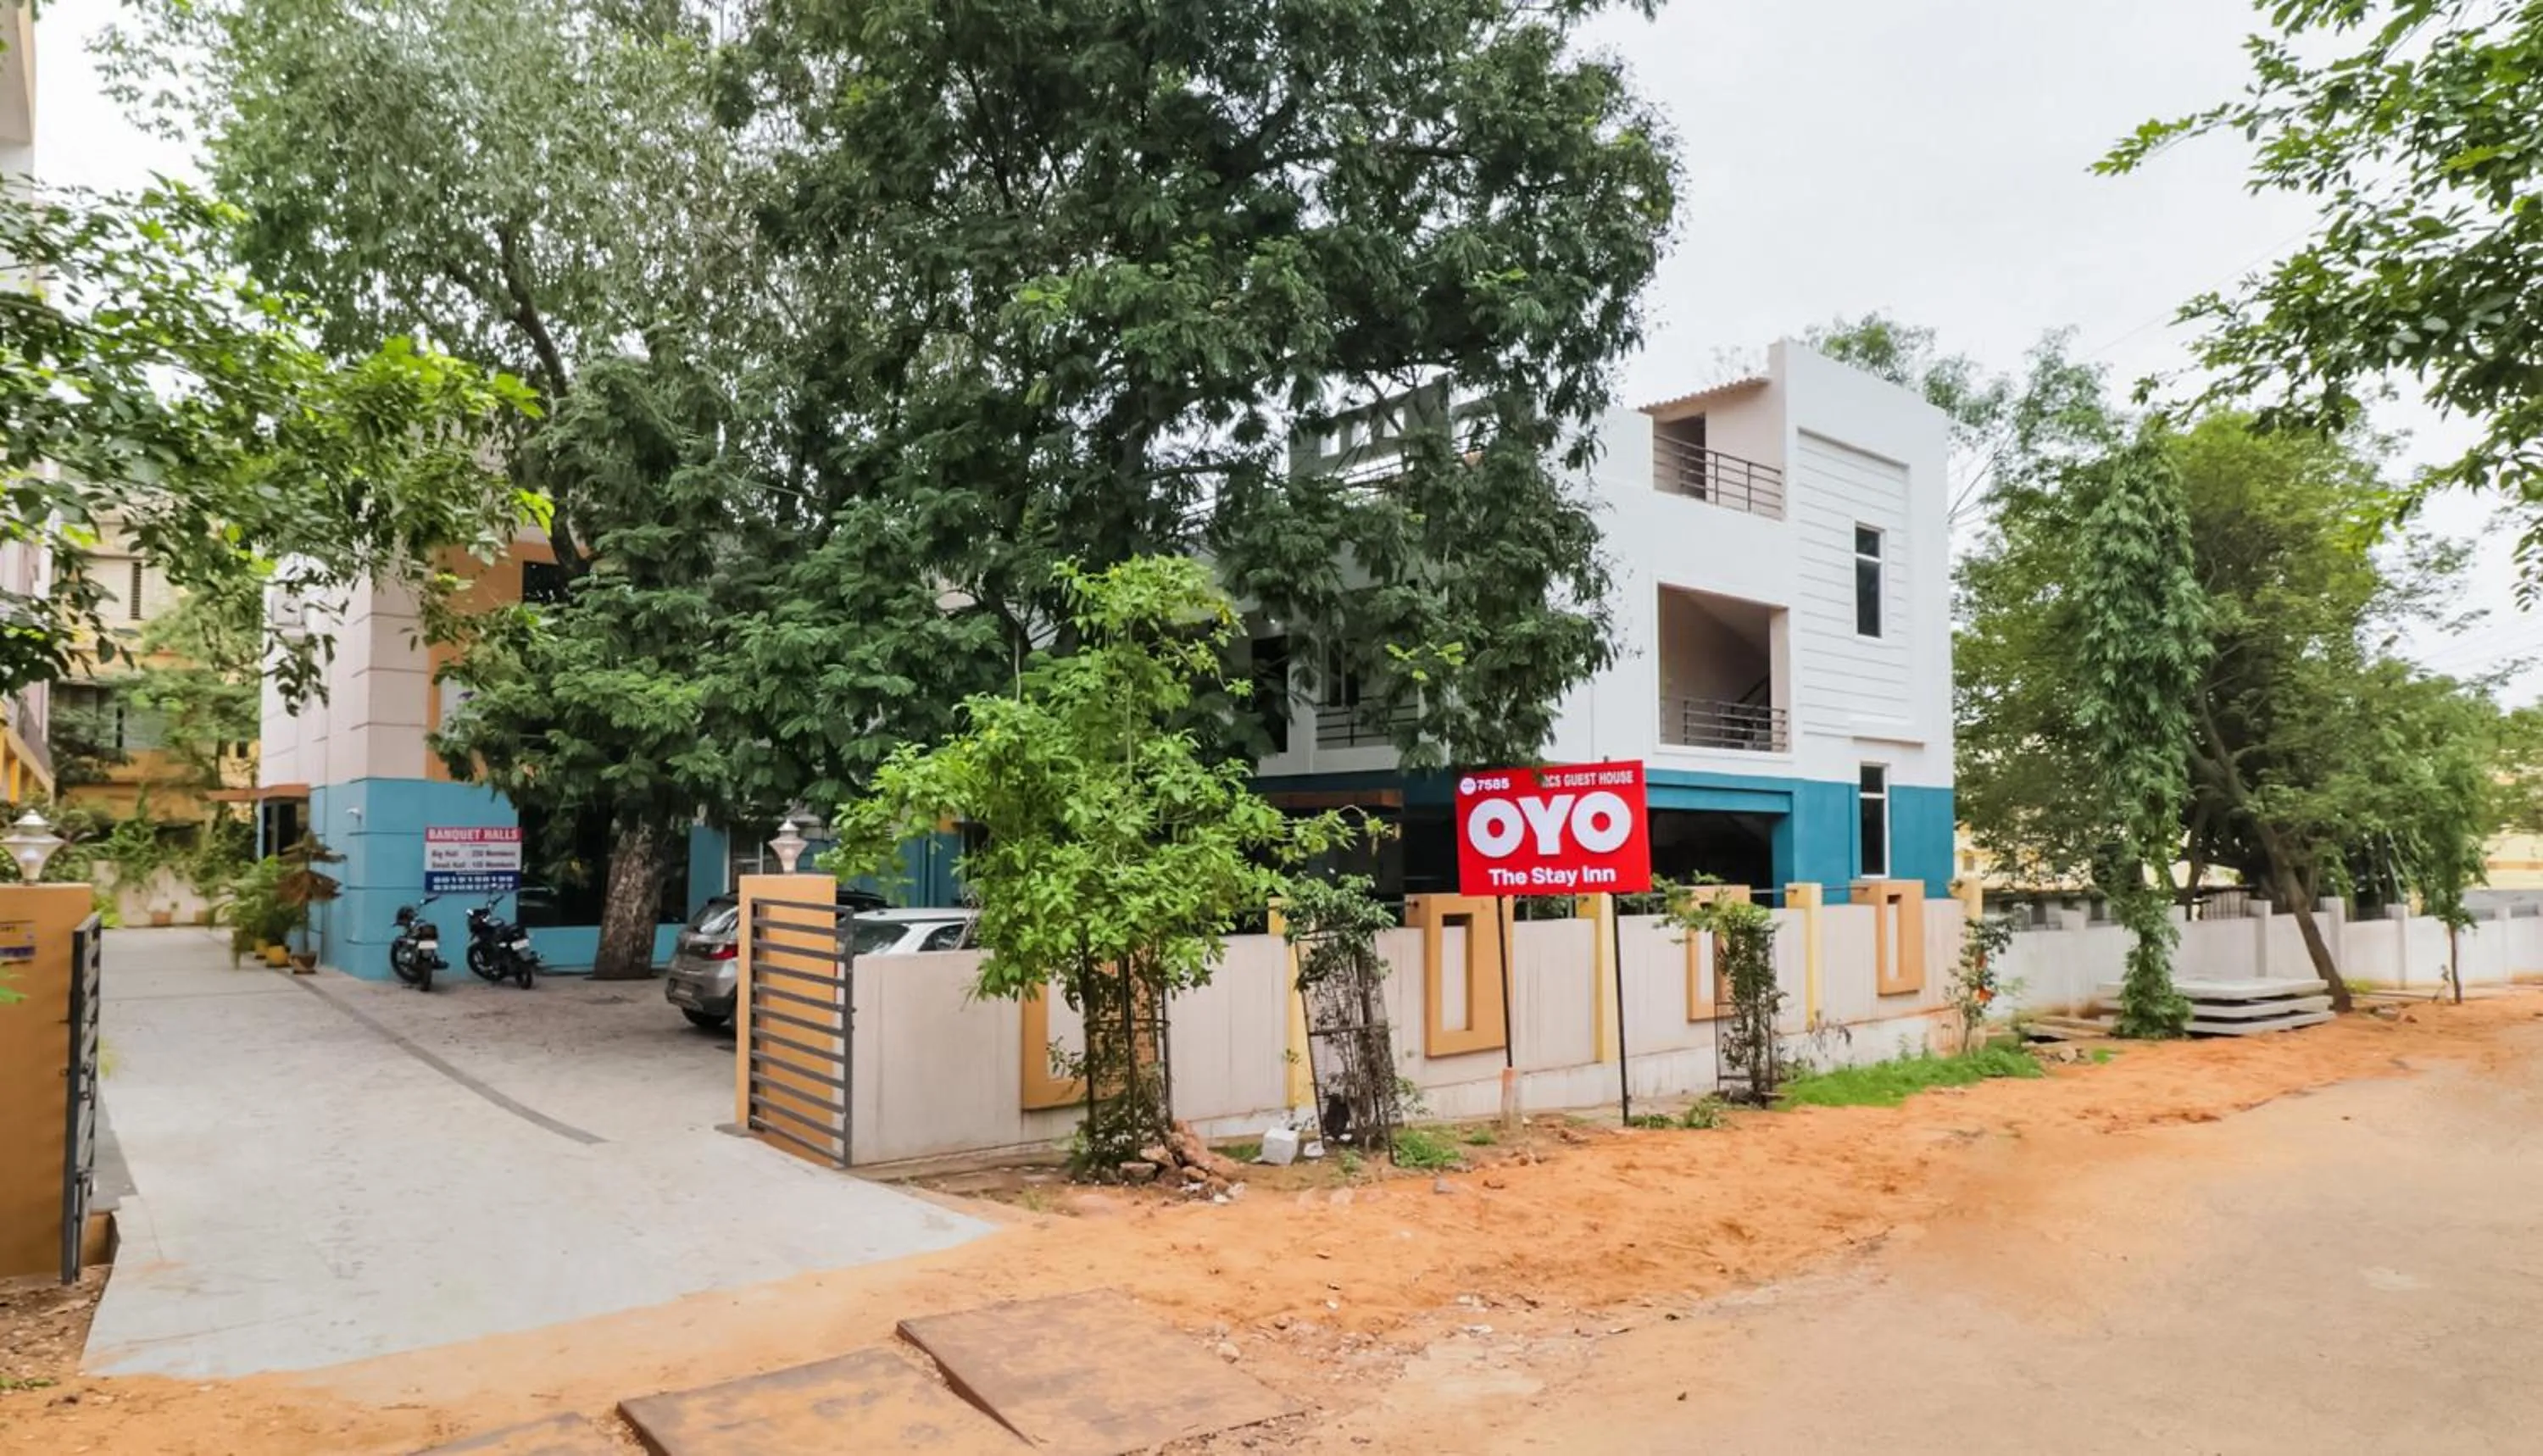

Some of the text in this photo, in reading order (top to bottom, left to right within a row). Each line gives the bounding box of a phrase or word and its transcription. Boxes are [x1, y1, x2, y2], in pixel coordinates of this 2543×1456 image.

[1564, 772, 1596, 786] GUEST
[1599, 770, 1634, 785] HOUSE
[428, 828, 517, 840] BANQUET HALLS
[1467, 791, 1633, 859] OYO
[1489, 865, 1617, 887] The Stay Inn
